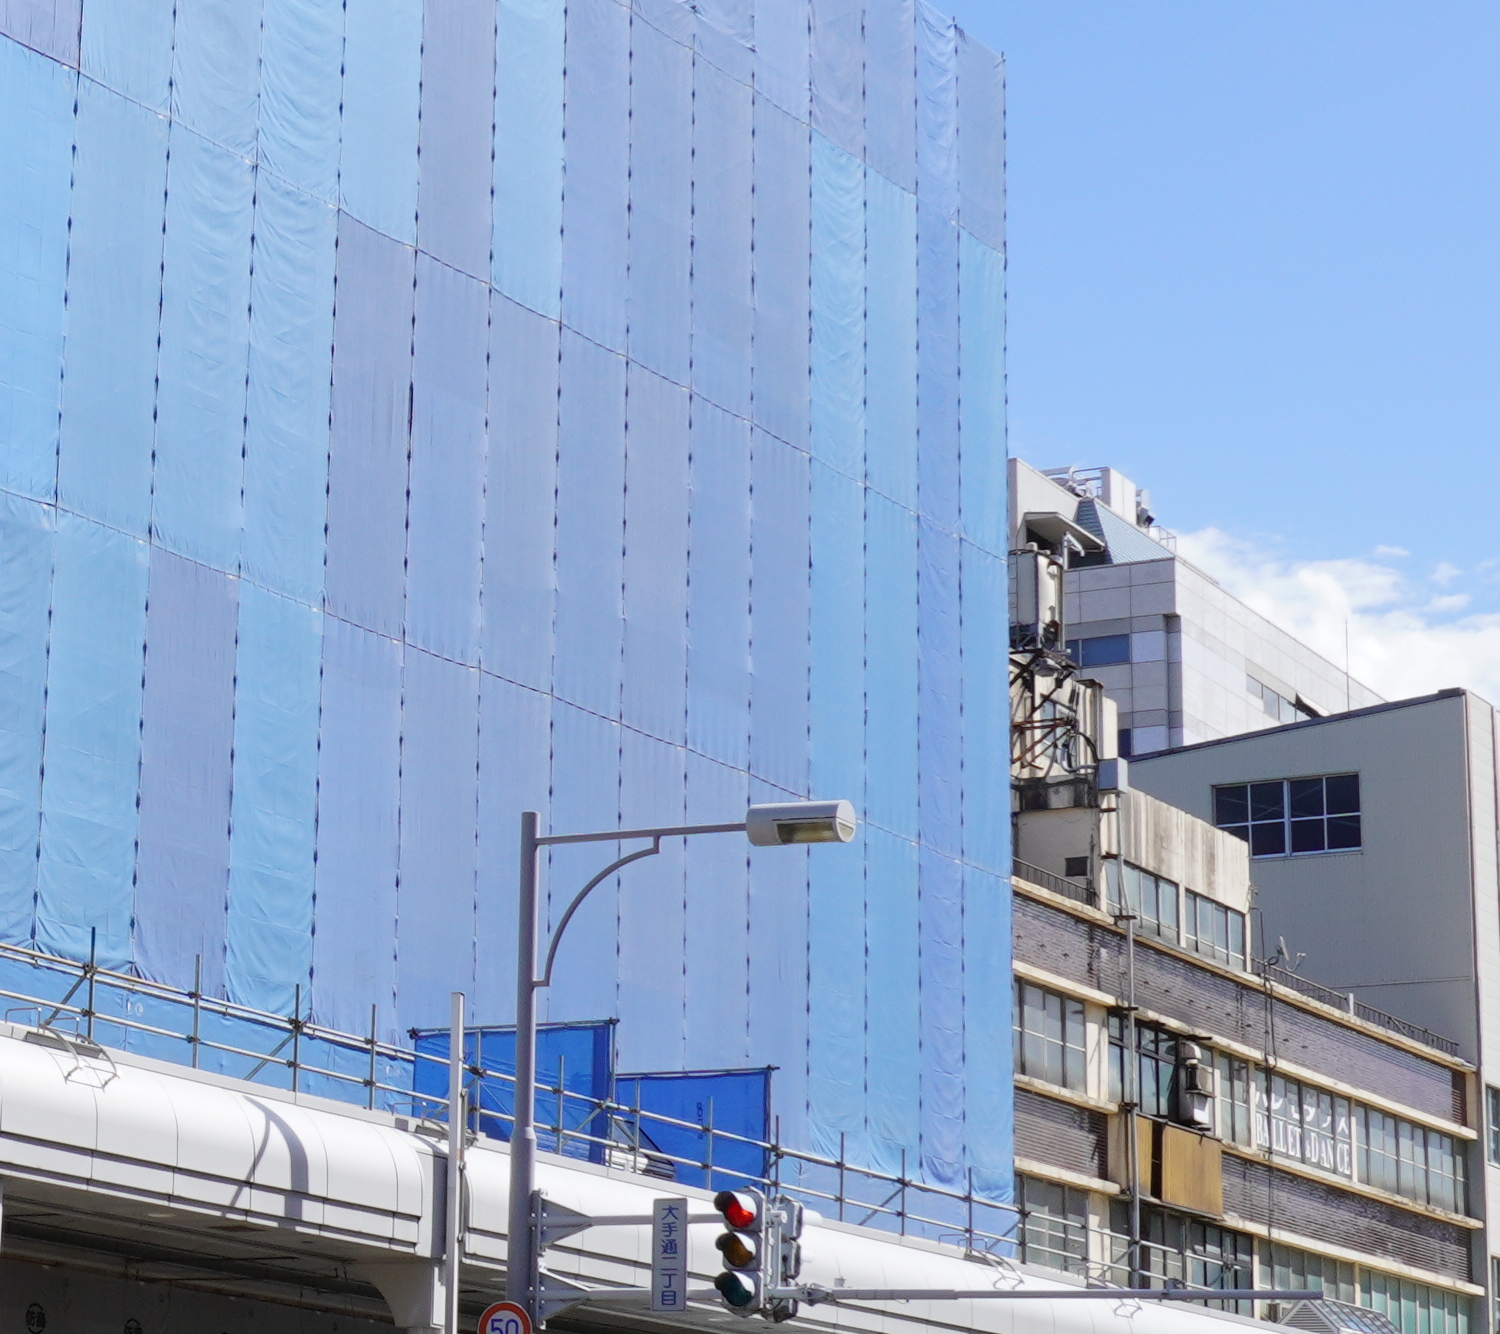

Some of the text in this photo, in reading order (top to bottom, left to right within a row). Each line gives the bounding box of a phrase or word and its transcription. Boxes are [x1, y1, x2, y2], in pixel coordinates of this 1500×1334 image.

[660, 1204, 679, 1306] 大手通二丁目
